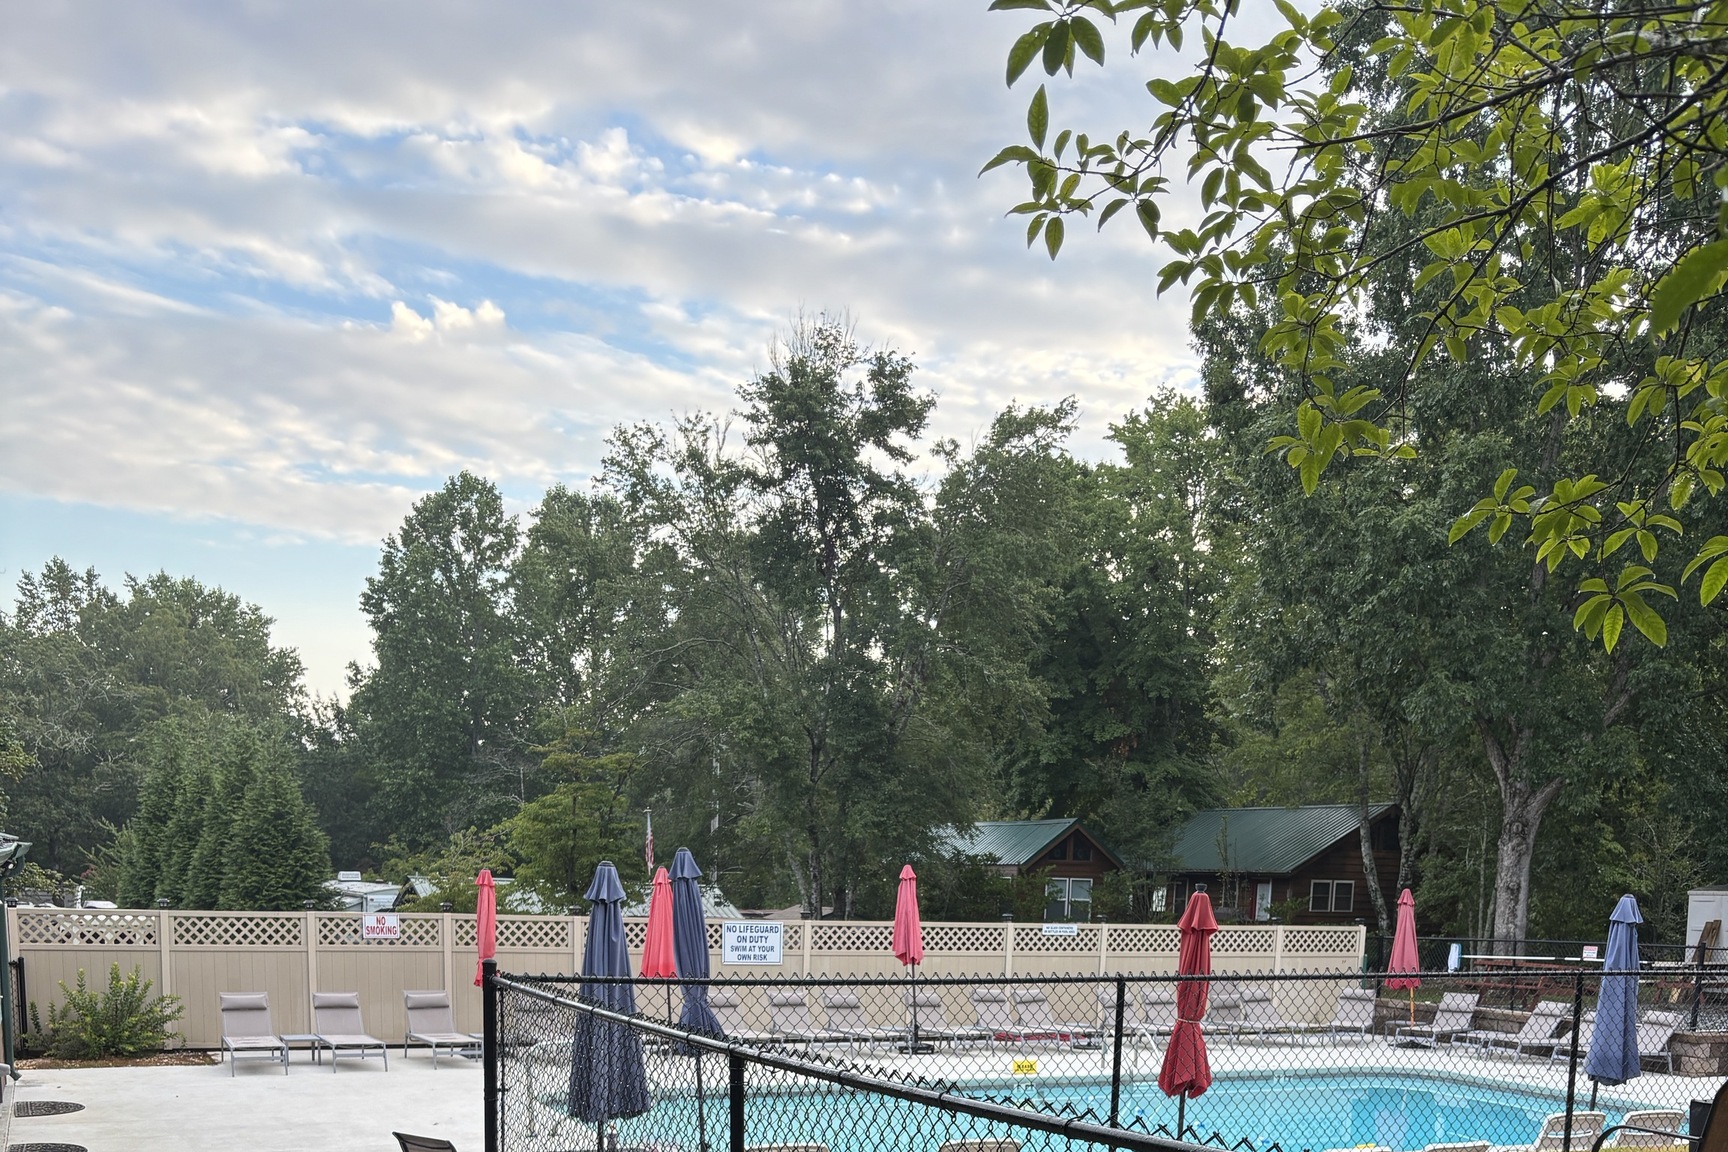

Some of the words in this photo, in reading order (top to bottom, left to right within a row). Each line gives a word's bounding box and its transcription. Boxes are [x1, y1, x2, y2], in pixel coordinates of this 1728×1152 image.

[376, 916, 386, 925] NO
[366, 926, 397, 935] SMOKING
[726, 925, 737, 933] NO
[738, 925, 779, 933] LIFEGUARD
[736, 935, 748, 943] ON
[749, 935, 769, 943] DUTY
[757, 945, 775, 953] YOUR
